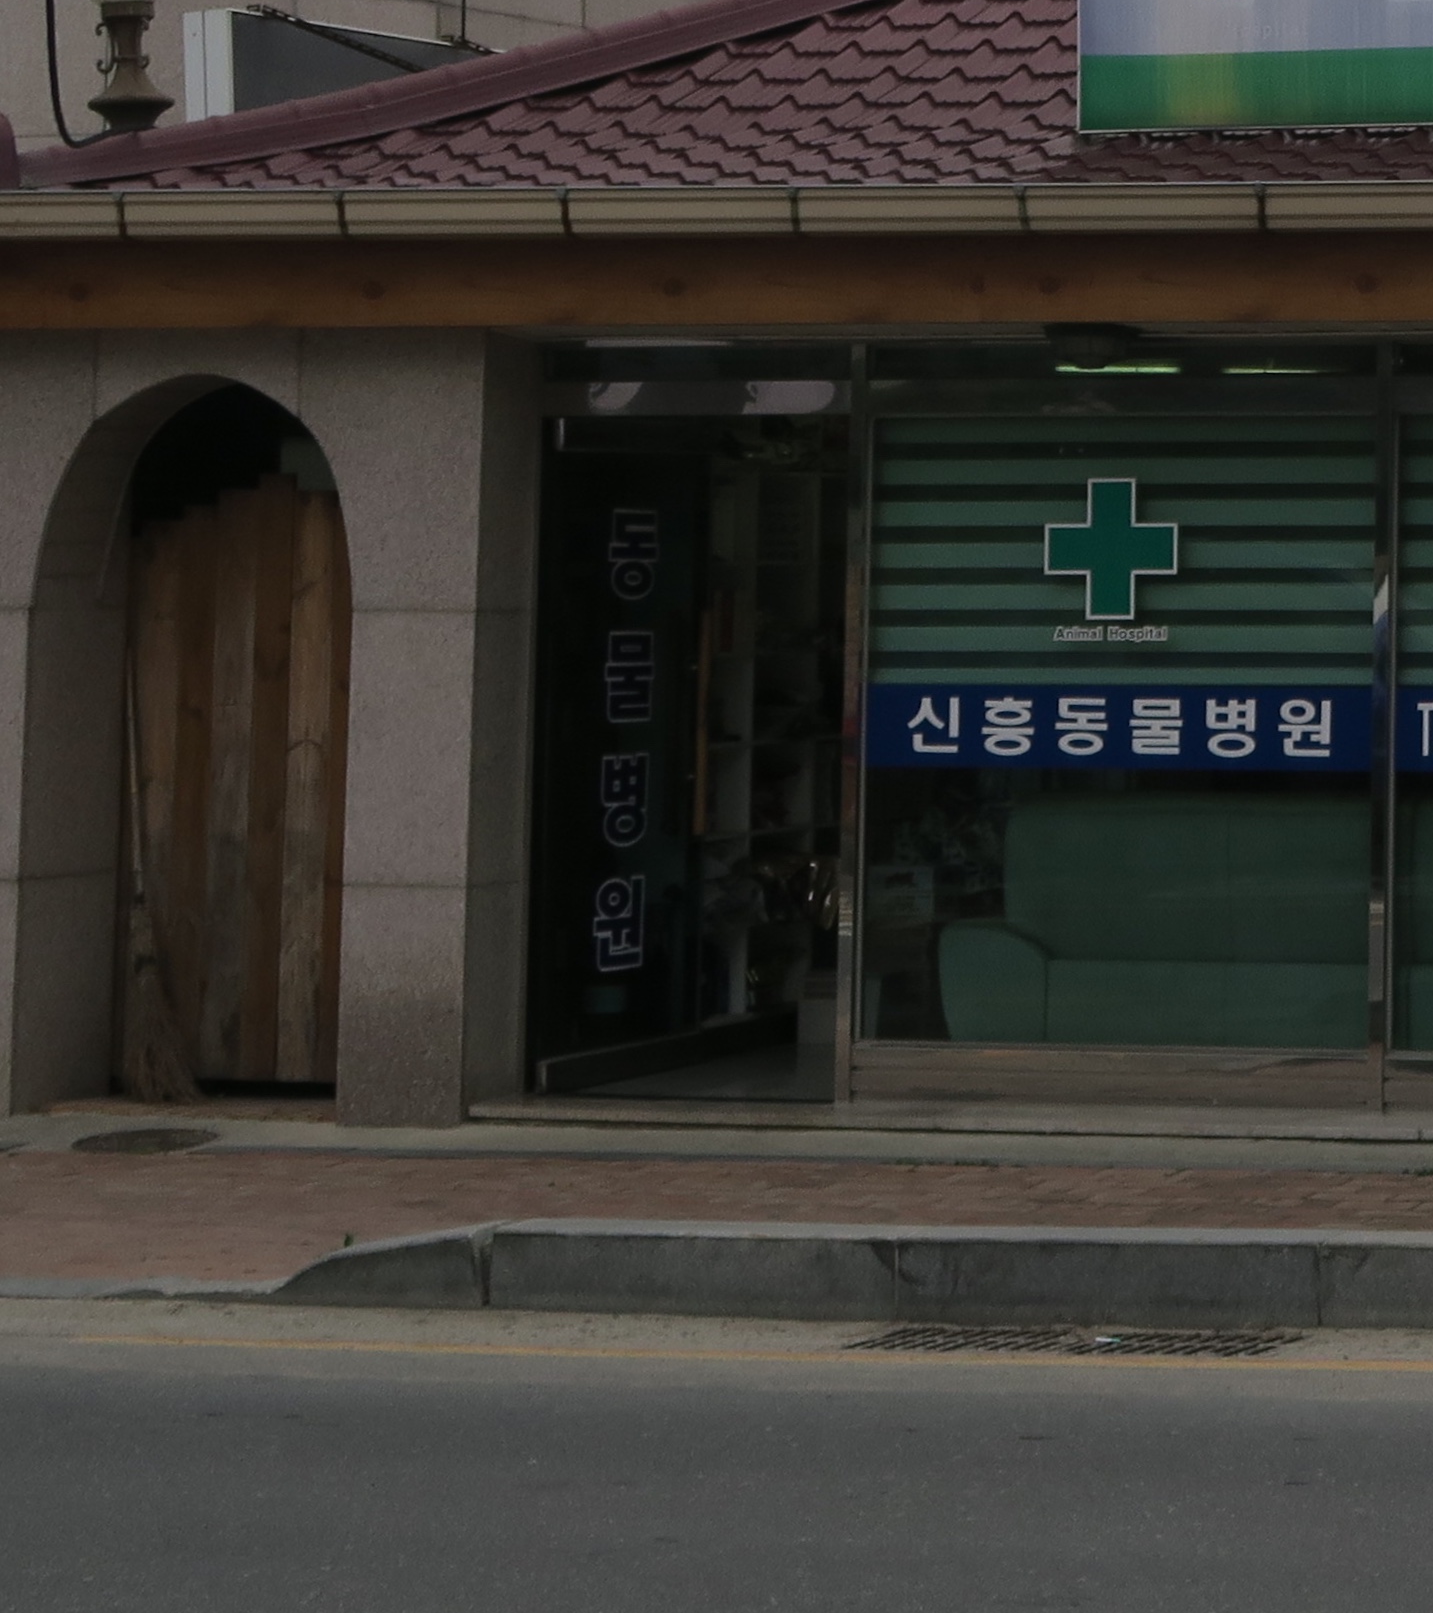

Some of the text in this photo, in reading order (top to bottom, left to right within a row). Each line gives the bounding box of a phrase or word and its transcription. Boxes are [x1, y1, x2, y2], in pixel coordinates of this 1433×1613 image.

[1055, 627, 1167, 641] Animal Hospital
[593, 508, 659, 972] 동물병원
[907, 696, 1332, 758] 신흥동물병원
